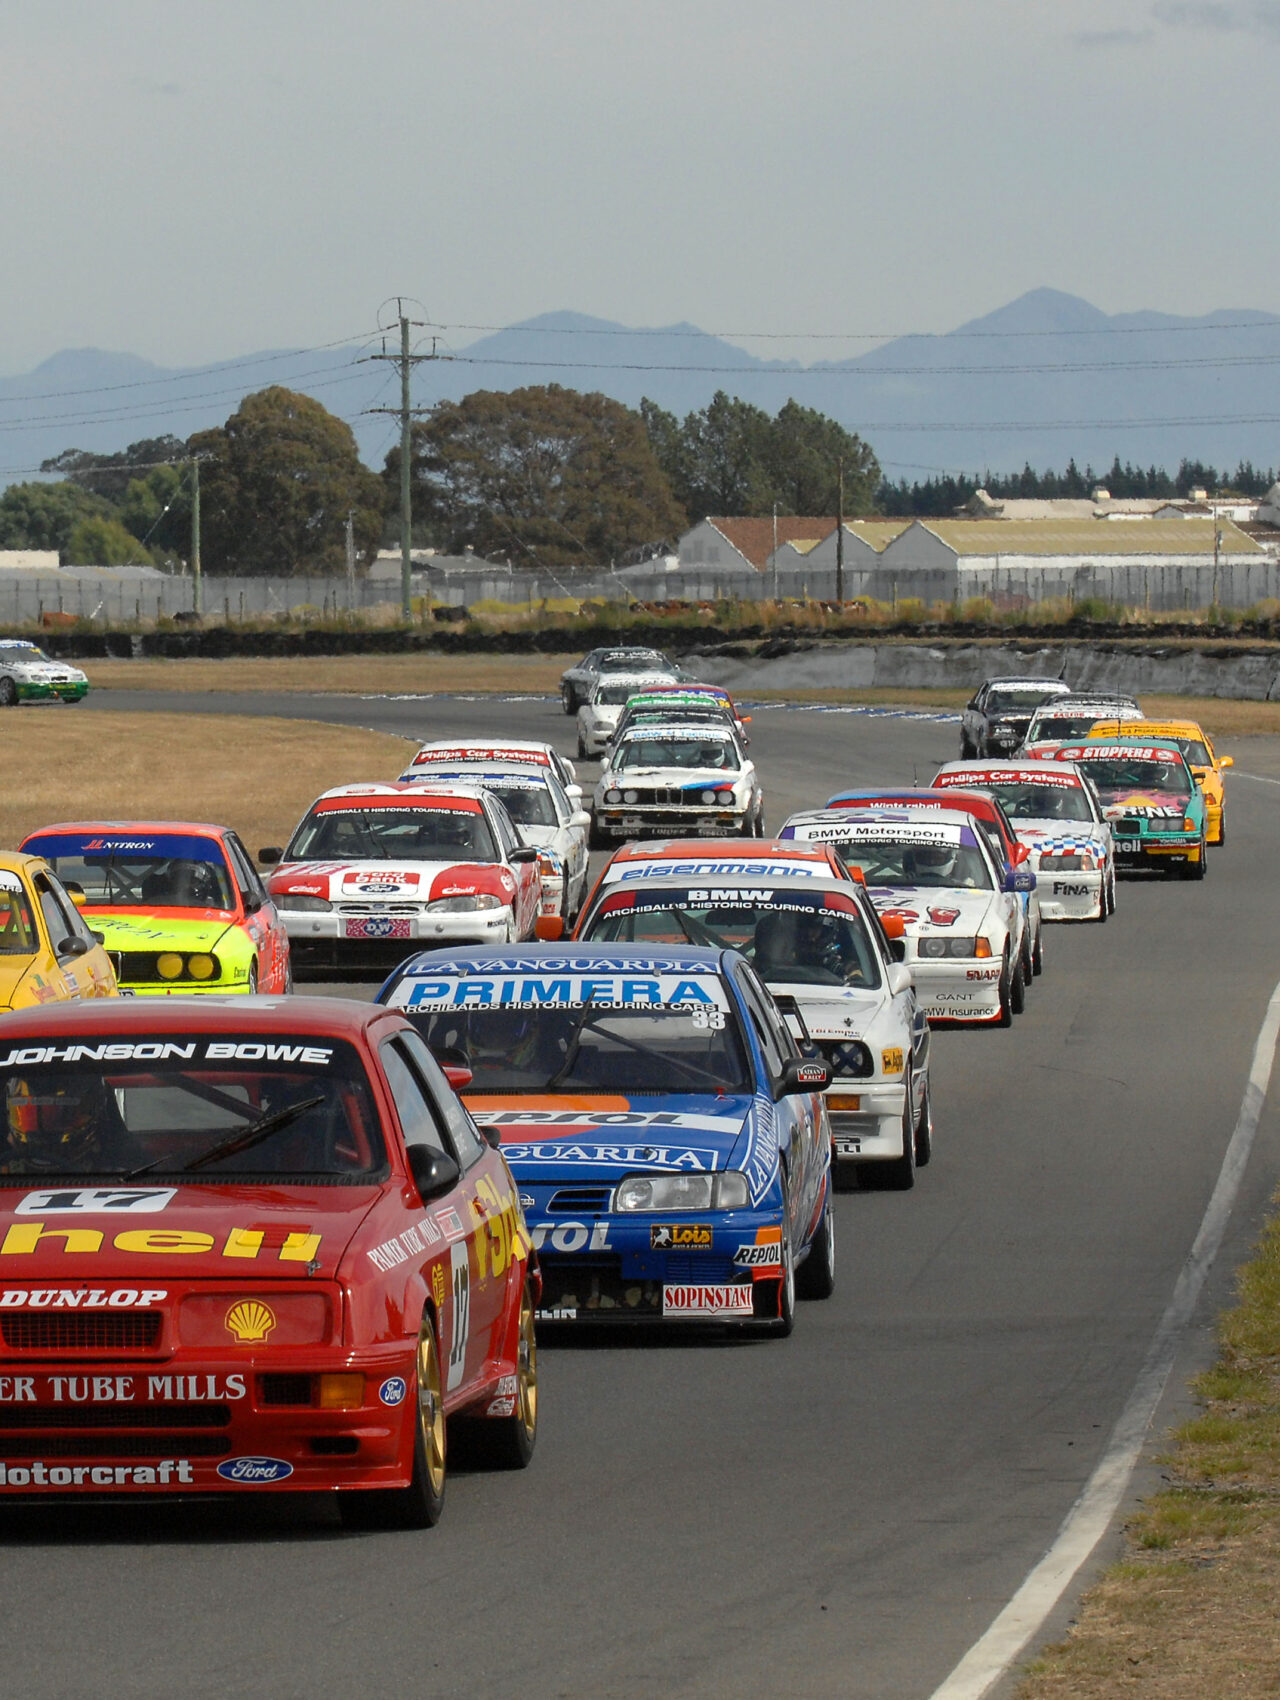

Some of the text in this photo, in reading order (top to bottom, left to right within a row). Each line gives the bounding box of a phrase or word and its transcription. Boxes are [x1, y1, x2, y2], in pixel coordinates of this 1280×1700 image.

[493, 750, 546, 761] Systems
[1082, 747, 1154, 759] STOPPERS
[989, 772, 1015, 781] Car
[1019, 772, 1075, 786] Systems
[412, 807, 451, 815] TOURING
[808, 826, 946, 839] BMW Motorsport
[894, 838, 933, 846] TOURING
[934, 841, 960, 849] CARS
[621, 863, 812, 881] eisenmann
[687, 890, 775, 901] BMW
[1053, 881, 1090, 896] FINA
[690, 901, 752, 910] HISTORIC
[754, 902, 814, 914] TOURING
[817, 909, 856, 922] CARS
[414, 958, 715, 973] LA VANGUARDIA
[407, 979, 714, 1006] PRIMERA
[936, 993, 975, 1001] GANT
[396, 1000, 717, 1013] ARCHIBALDS HISTORIC TOURING CARS
[948, 1006, 995, 1017] Insurance
[692, 1011, 725, 1030] 33
[205, 1043, 333, 1065] BOWE
[469, 1111, 685, 1126] EPSOL
[500, 1145, 706, 1171] GUARDIA
[746, 1159, 768, 1196] LA
[29, 1189, 170, 1210] 17
[672, 1226, 711, 1243] Lois
[366, 1237, 408, 1273] PALMER
[417, 1216, 442, 1247] MILLS
[734, 1247, 781, 1264] REPSOL
[665, 1286, 753, 1308] SOPINSTANT
[535, 1308, 577, 1319] ELIN
[47, 1375, 135, 1401] TUBE
[148, 1373, 246, 1401] MILLS
[385, 1380, 402, 1402] Ford
[230, 1459, 278, 1479] Ford
